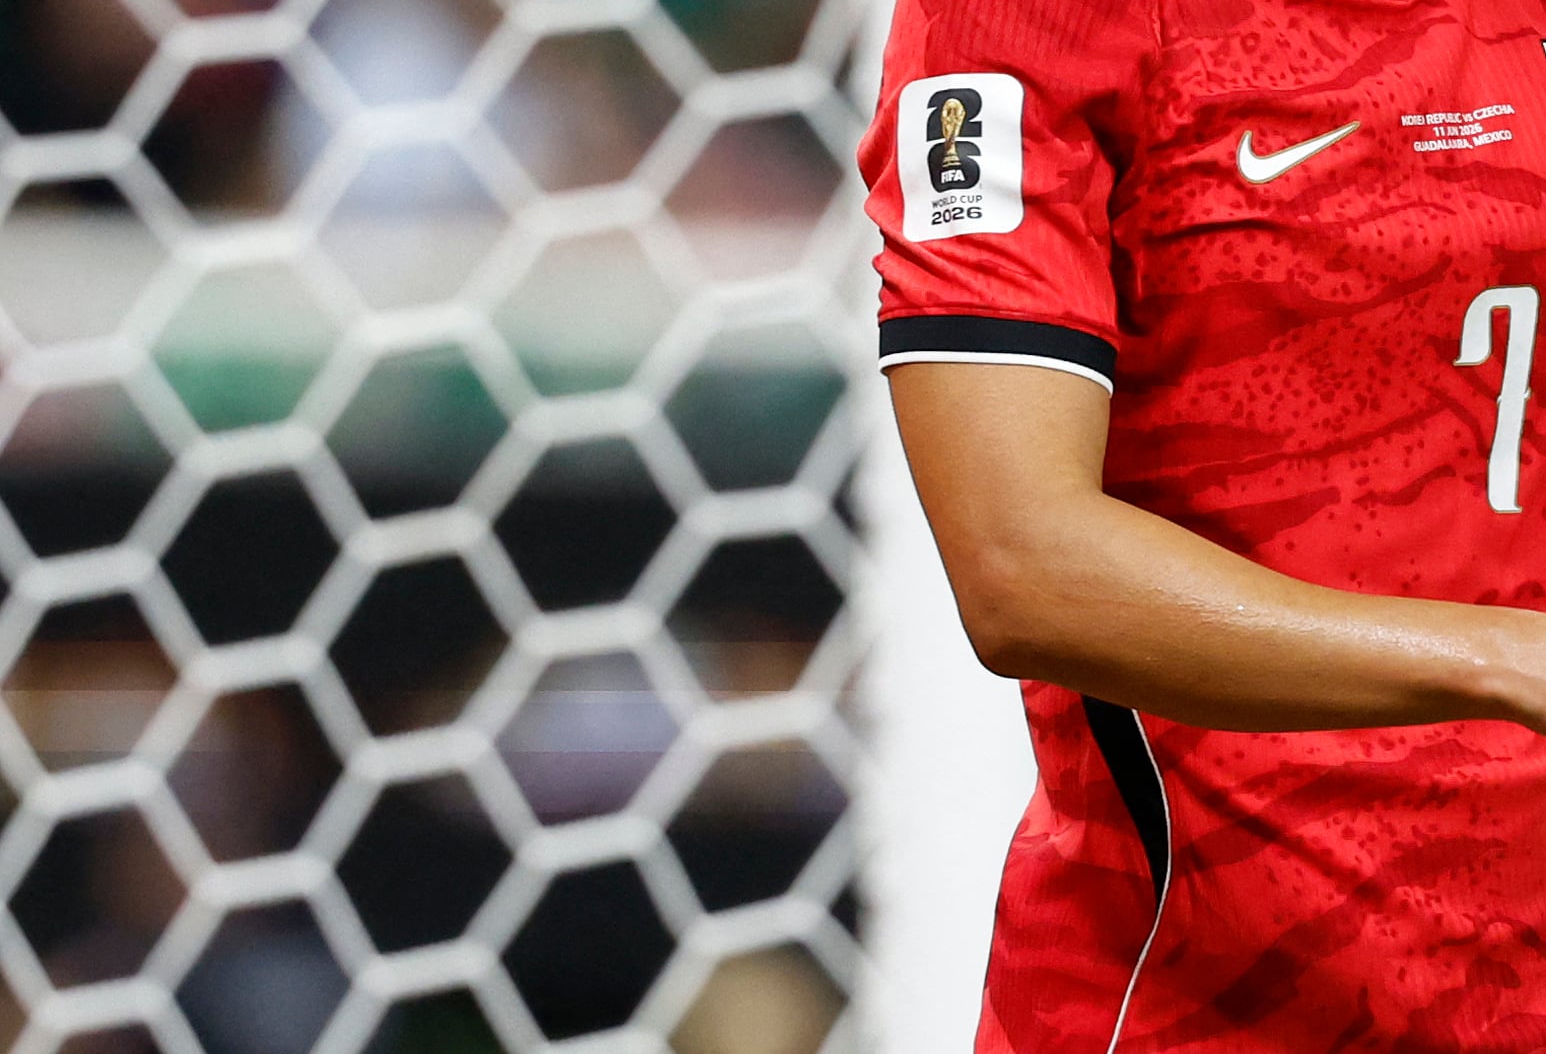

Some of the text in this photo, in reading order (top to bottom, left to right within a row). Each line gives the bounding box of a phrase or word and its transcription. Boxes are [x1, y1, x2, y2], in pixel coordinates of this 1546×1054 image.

[1432, 126, 1445, 137] 11
[1459, 123, 1483, 136] 2026
[1472, 130, 1513, 147] MEXICO
[941, 169, 966, 184] FIFA
[931, 194, 983, 208] WORLD CUP
[931, 206, 983, 225] 2026
[1453, 284, 1541, 514] 7
